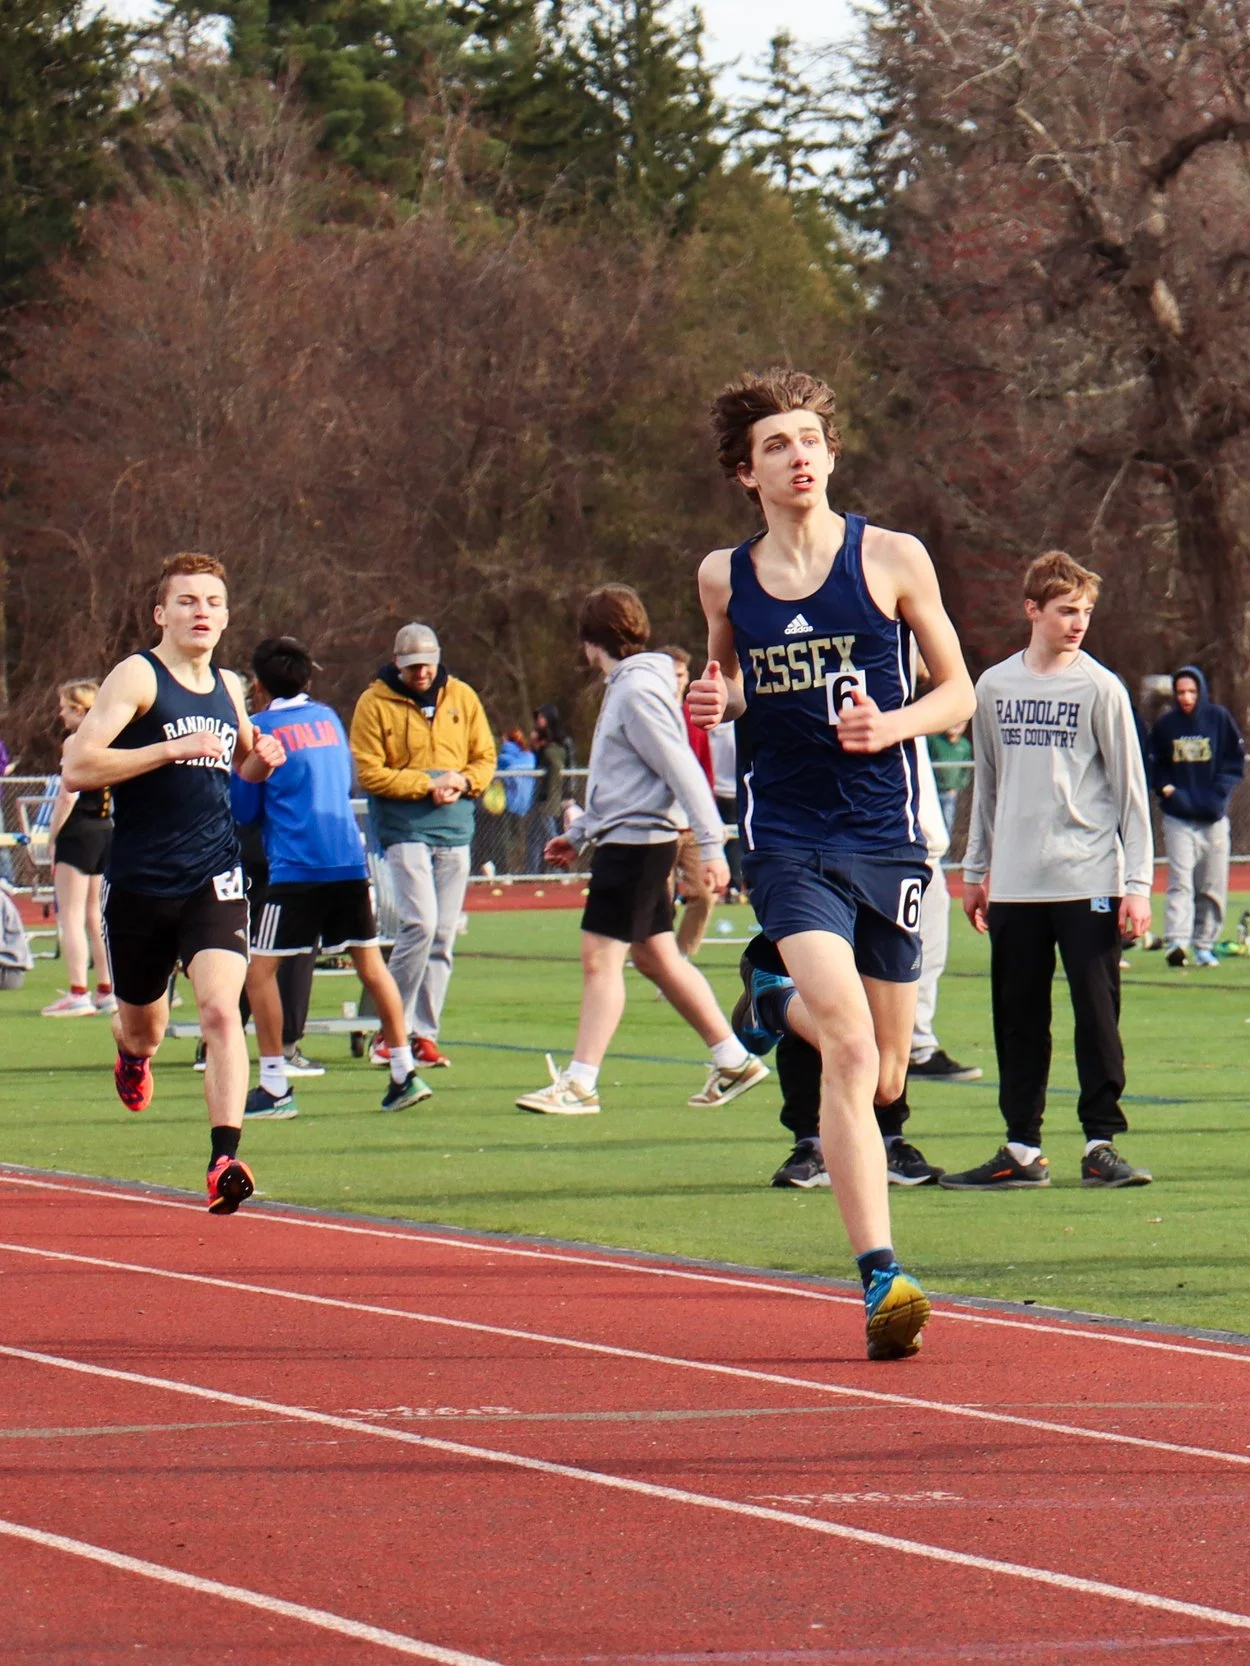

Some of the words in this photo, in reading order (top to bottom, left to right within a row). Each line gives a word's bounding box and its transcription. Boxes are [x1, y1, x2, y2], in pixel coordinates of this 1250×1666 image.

[784, 626, 814, 635] adidas
[749, 635, 856, 695] ESSEX
[832, 675, 860, 720] 6
[996, 699, 1080, 728] RANDOLPH
[272, 719, 340, 752] ITALIA
[1024, 729, 1077, 748] COUNTRY
[903, 883, 919, 928] 6
